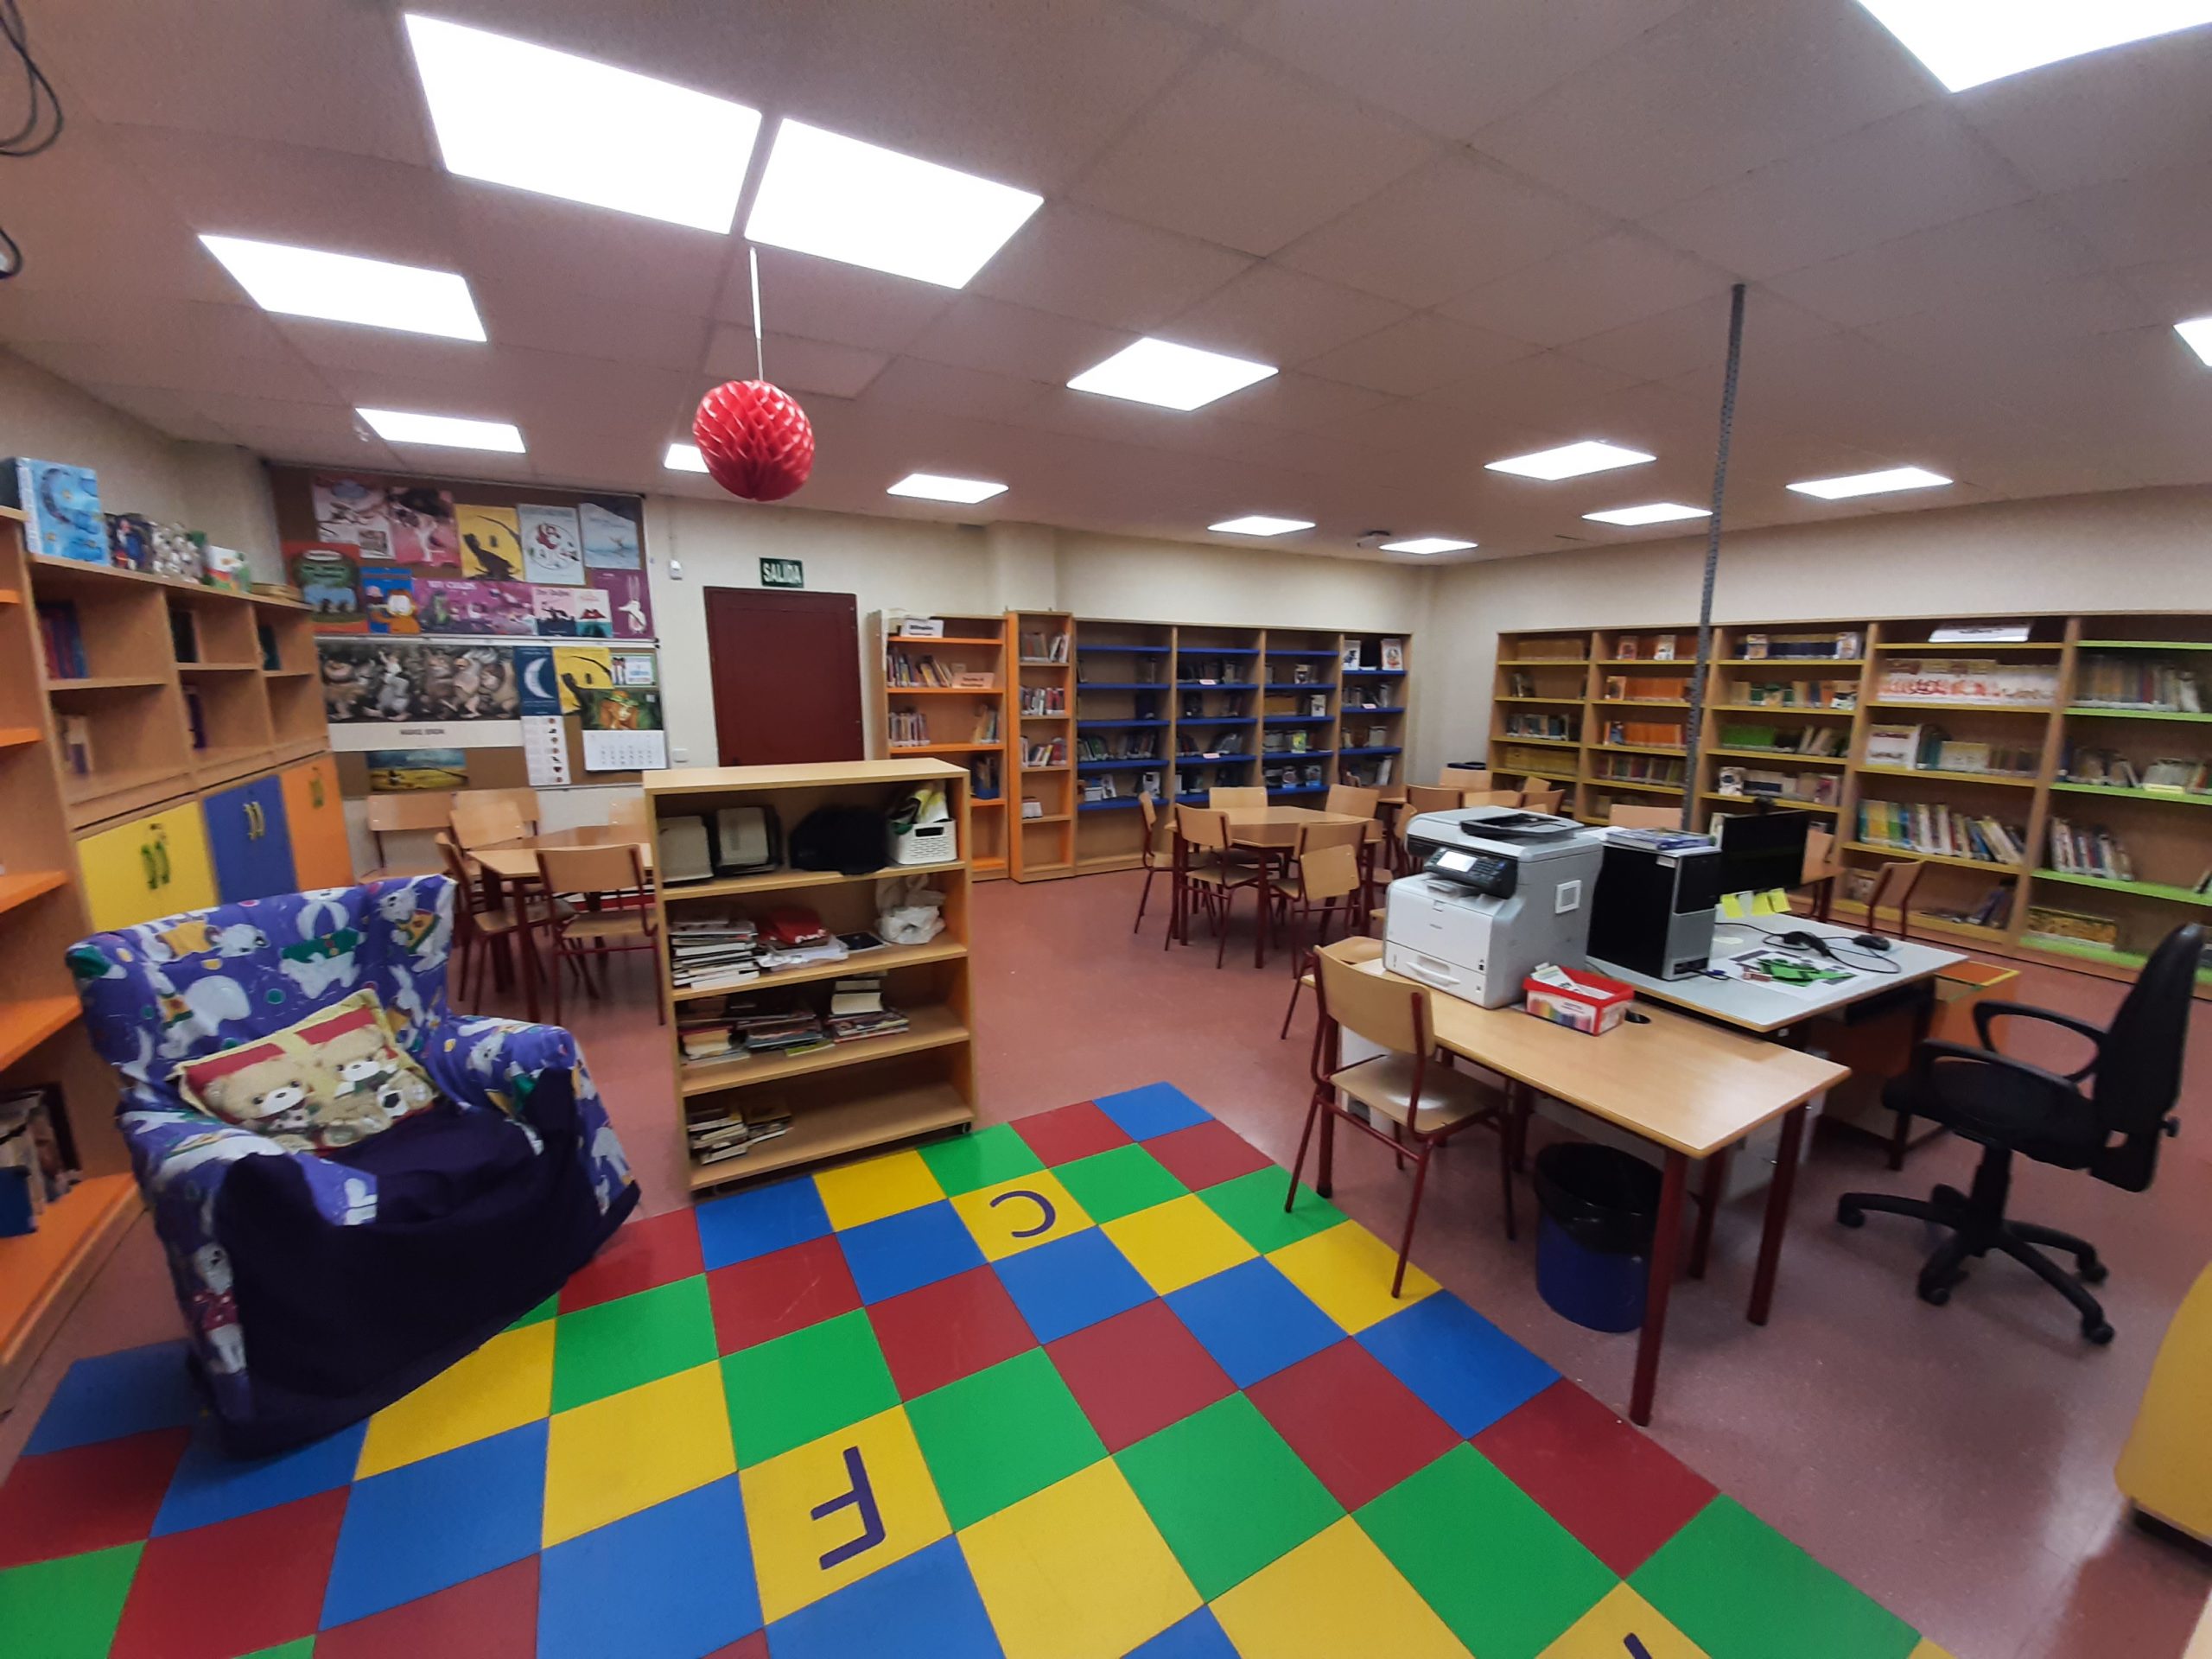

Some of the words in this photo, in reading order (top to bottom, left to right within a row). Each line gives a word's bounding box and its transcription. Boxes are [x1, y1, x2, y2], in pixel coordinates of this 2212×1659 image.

[763, 563, 802, 583] SALIDA
[989, 1191, 1056, 1237] C
[810, 1446, 886, 1570] F
